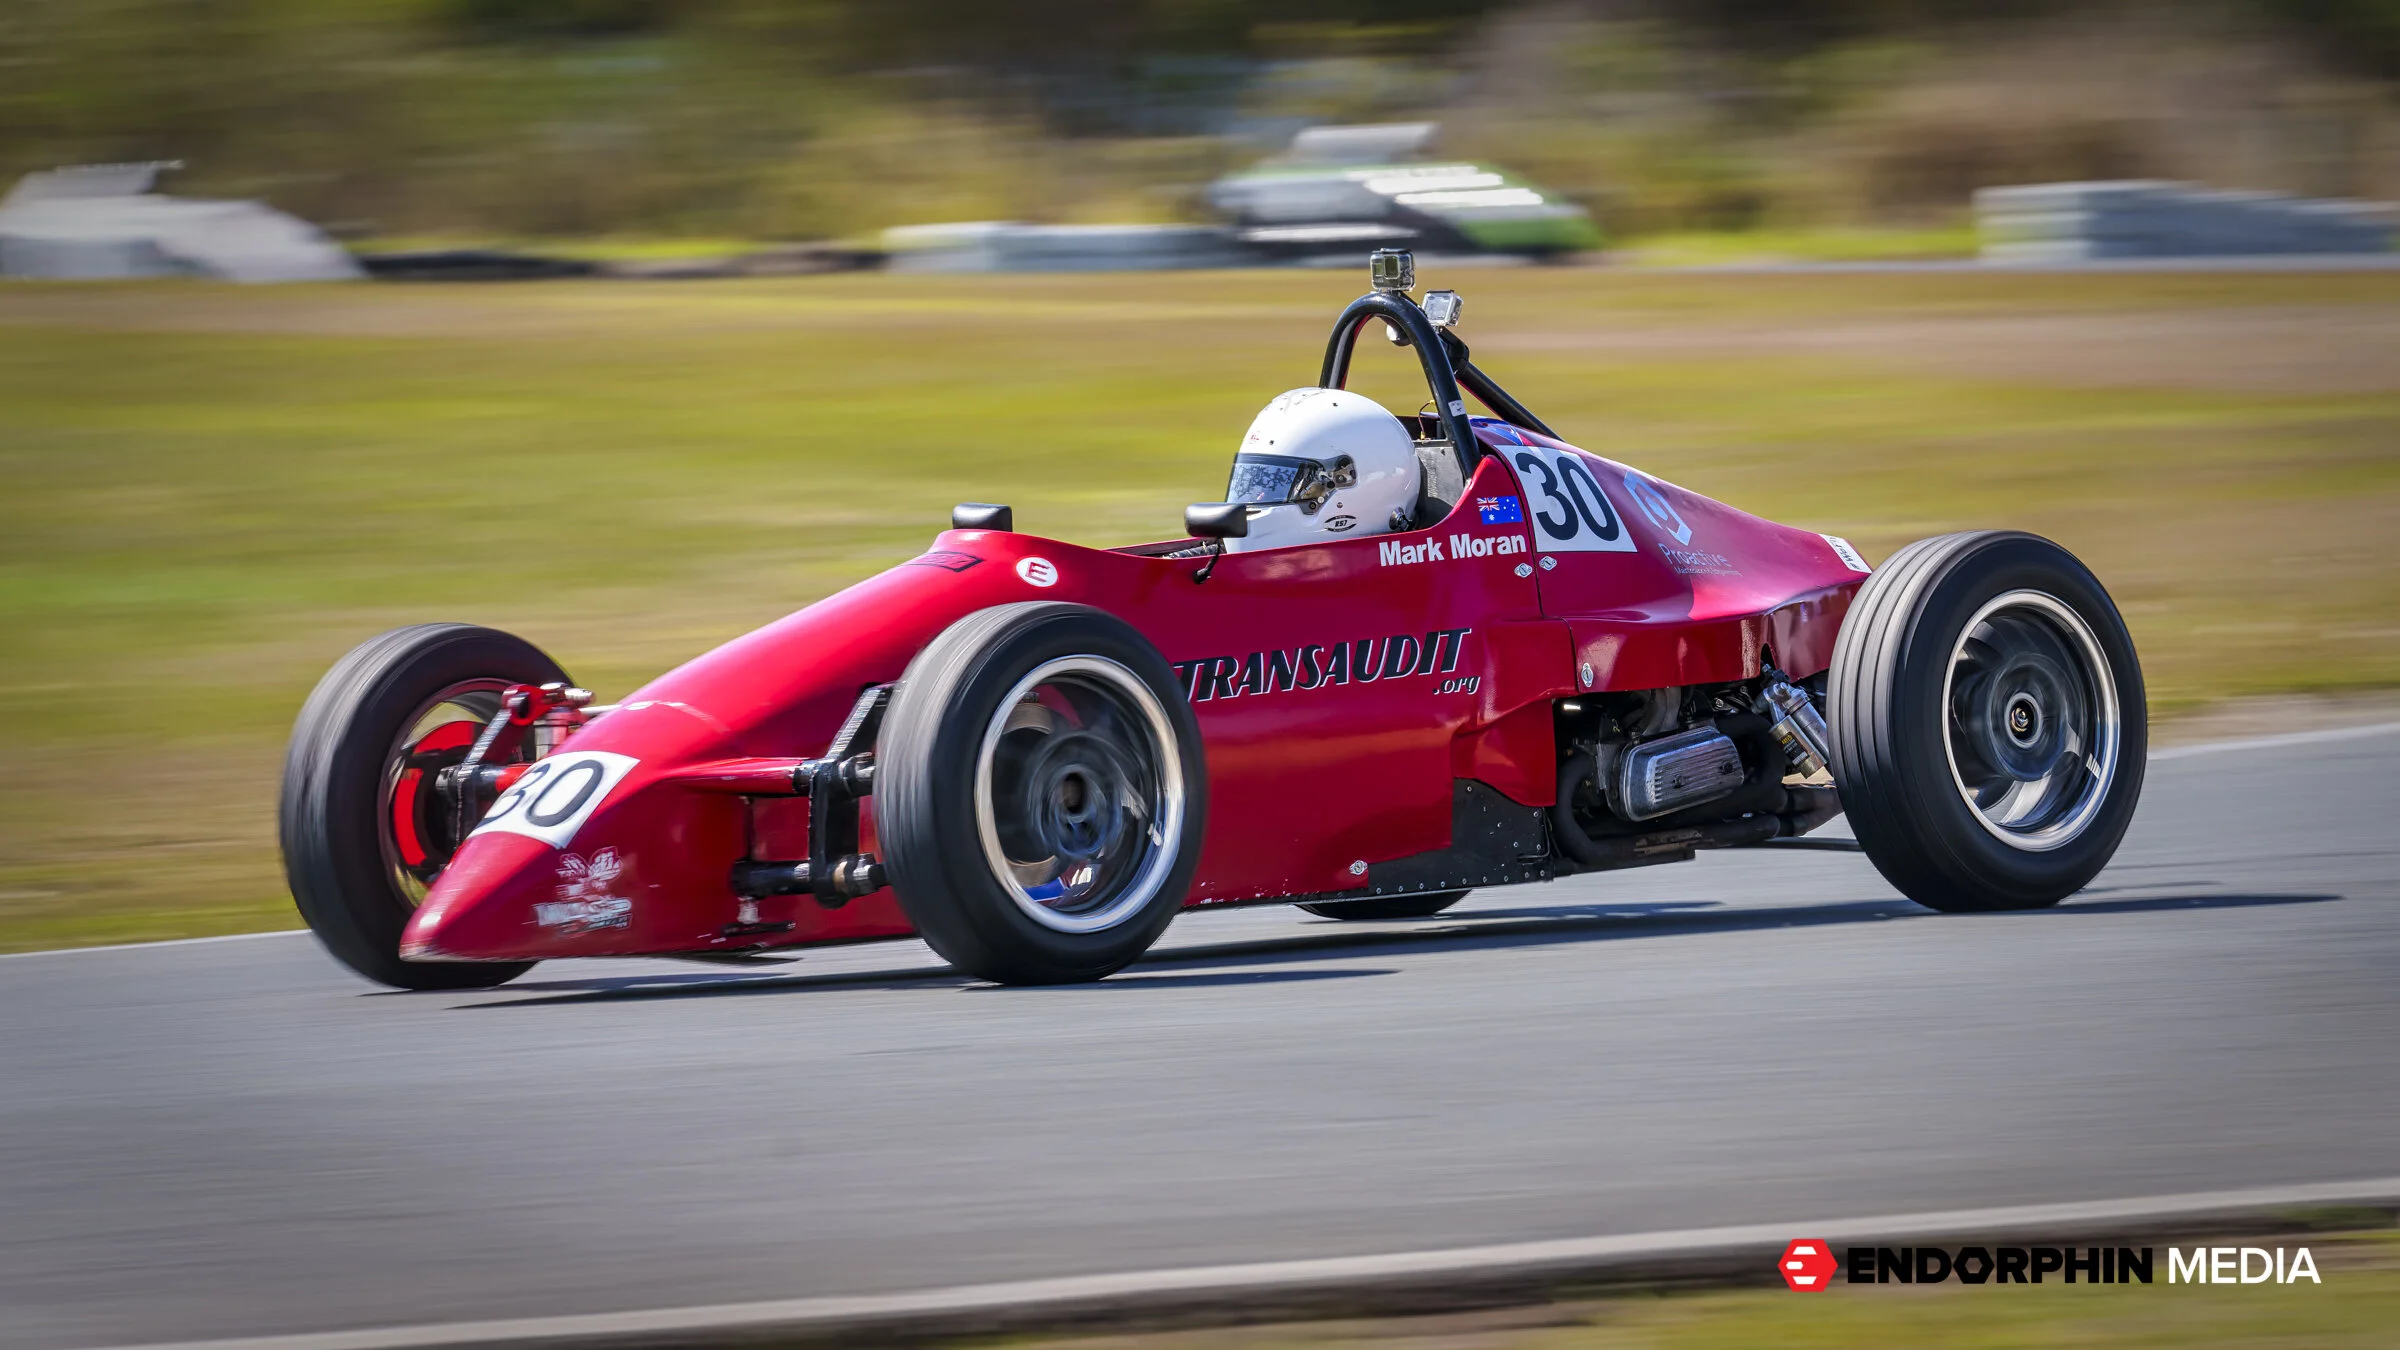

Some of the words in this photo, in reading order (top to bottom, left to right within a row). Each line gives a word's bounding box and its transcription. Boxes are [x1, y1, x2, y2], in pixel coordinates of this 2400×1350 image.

[1515, 452, 1620, 541] 30
[1378, 537, 1445, 567] Mark
[1449, 533, 1527, 560] Moran
[1657, 542, 1732, 567] Proactive
[1024, 561, 1051, 583] E
[1172, 628, 1472, 703] TRANSAUDIT
[1432, 676, 1481, 695] .org
[475, 759, 605, 828] 30
